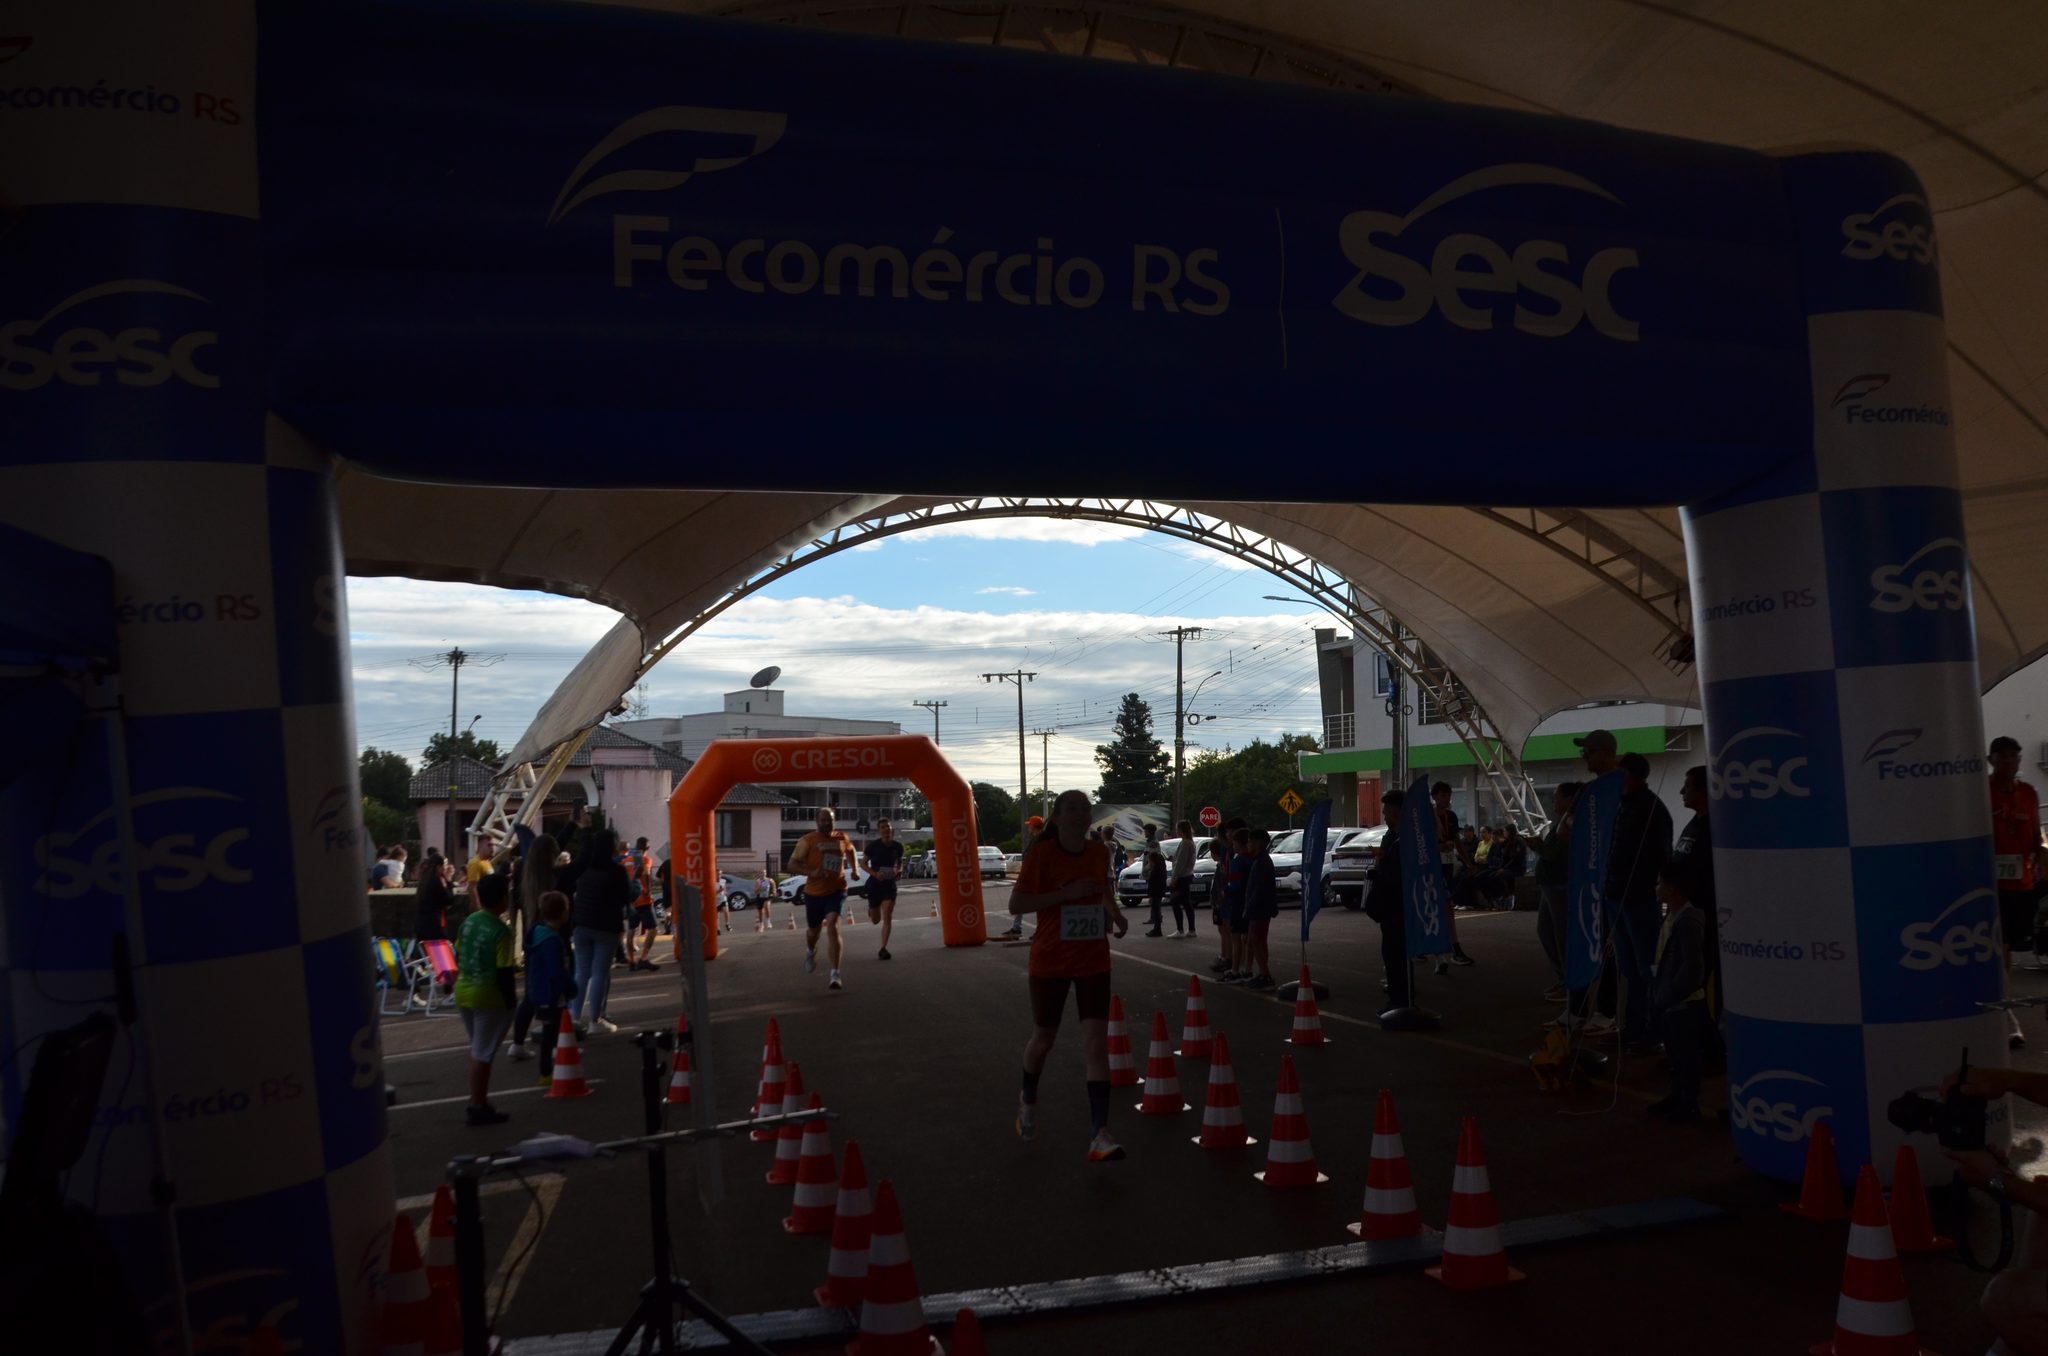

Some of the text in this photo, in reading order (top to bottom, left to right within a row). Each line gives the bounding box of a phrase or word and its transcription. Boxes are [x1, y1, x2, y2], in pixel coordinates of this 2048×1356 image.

[193, 92, 241, 126] RS
[612, 212, 1232, 318] Fecomércio RS
[1331, 208, 1641, 343] Sesc
[1782, 588, 1817, 610] RS
[1868, 563, 1965, 614] Ses
[215, 593, 262, 622] RS
[789, 746, 896, 770] CRESOL
[685, 826, 706, 887] ESOL
[952, 810, 975, 897] CRESOL
[1066, 918, 1099, 937] 226
[1811, 941, 1846, 961] RS
[260, 1073, 304, 1105] RS
